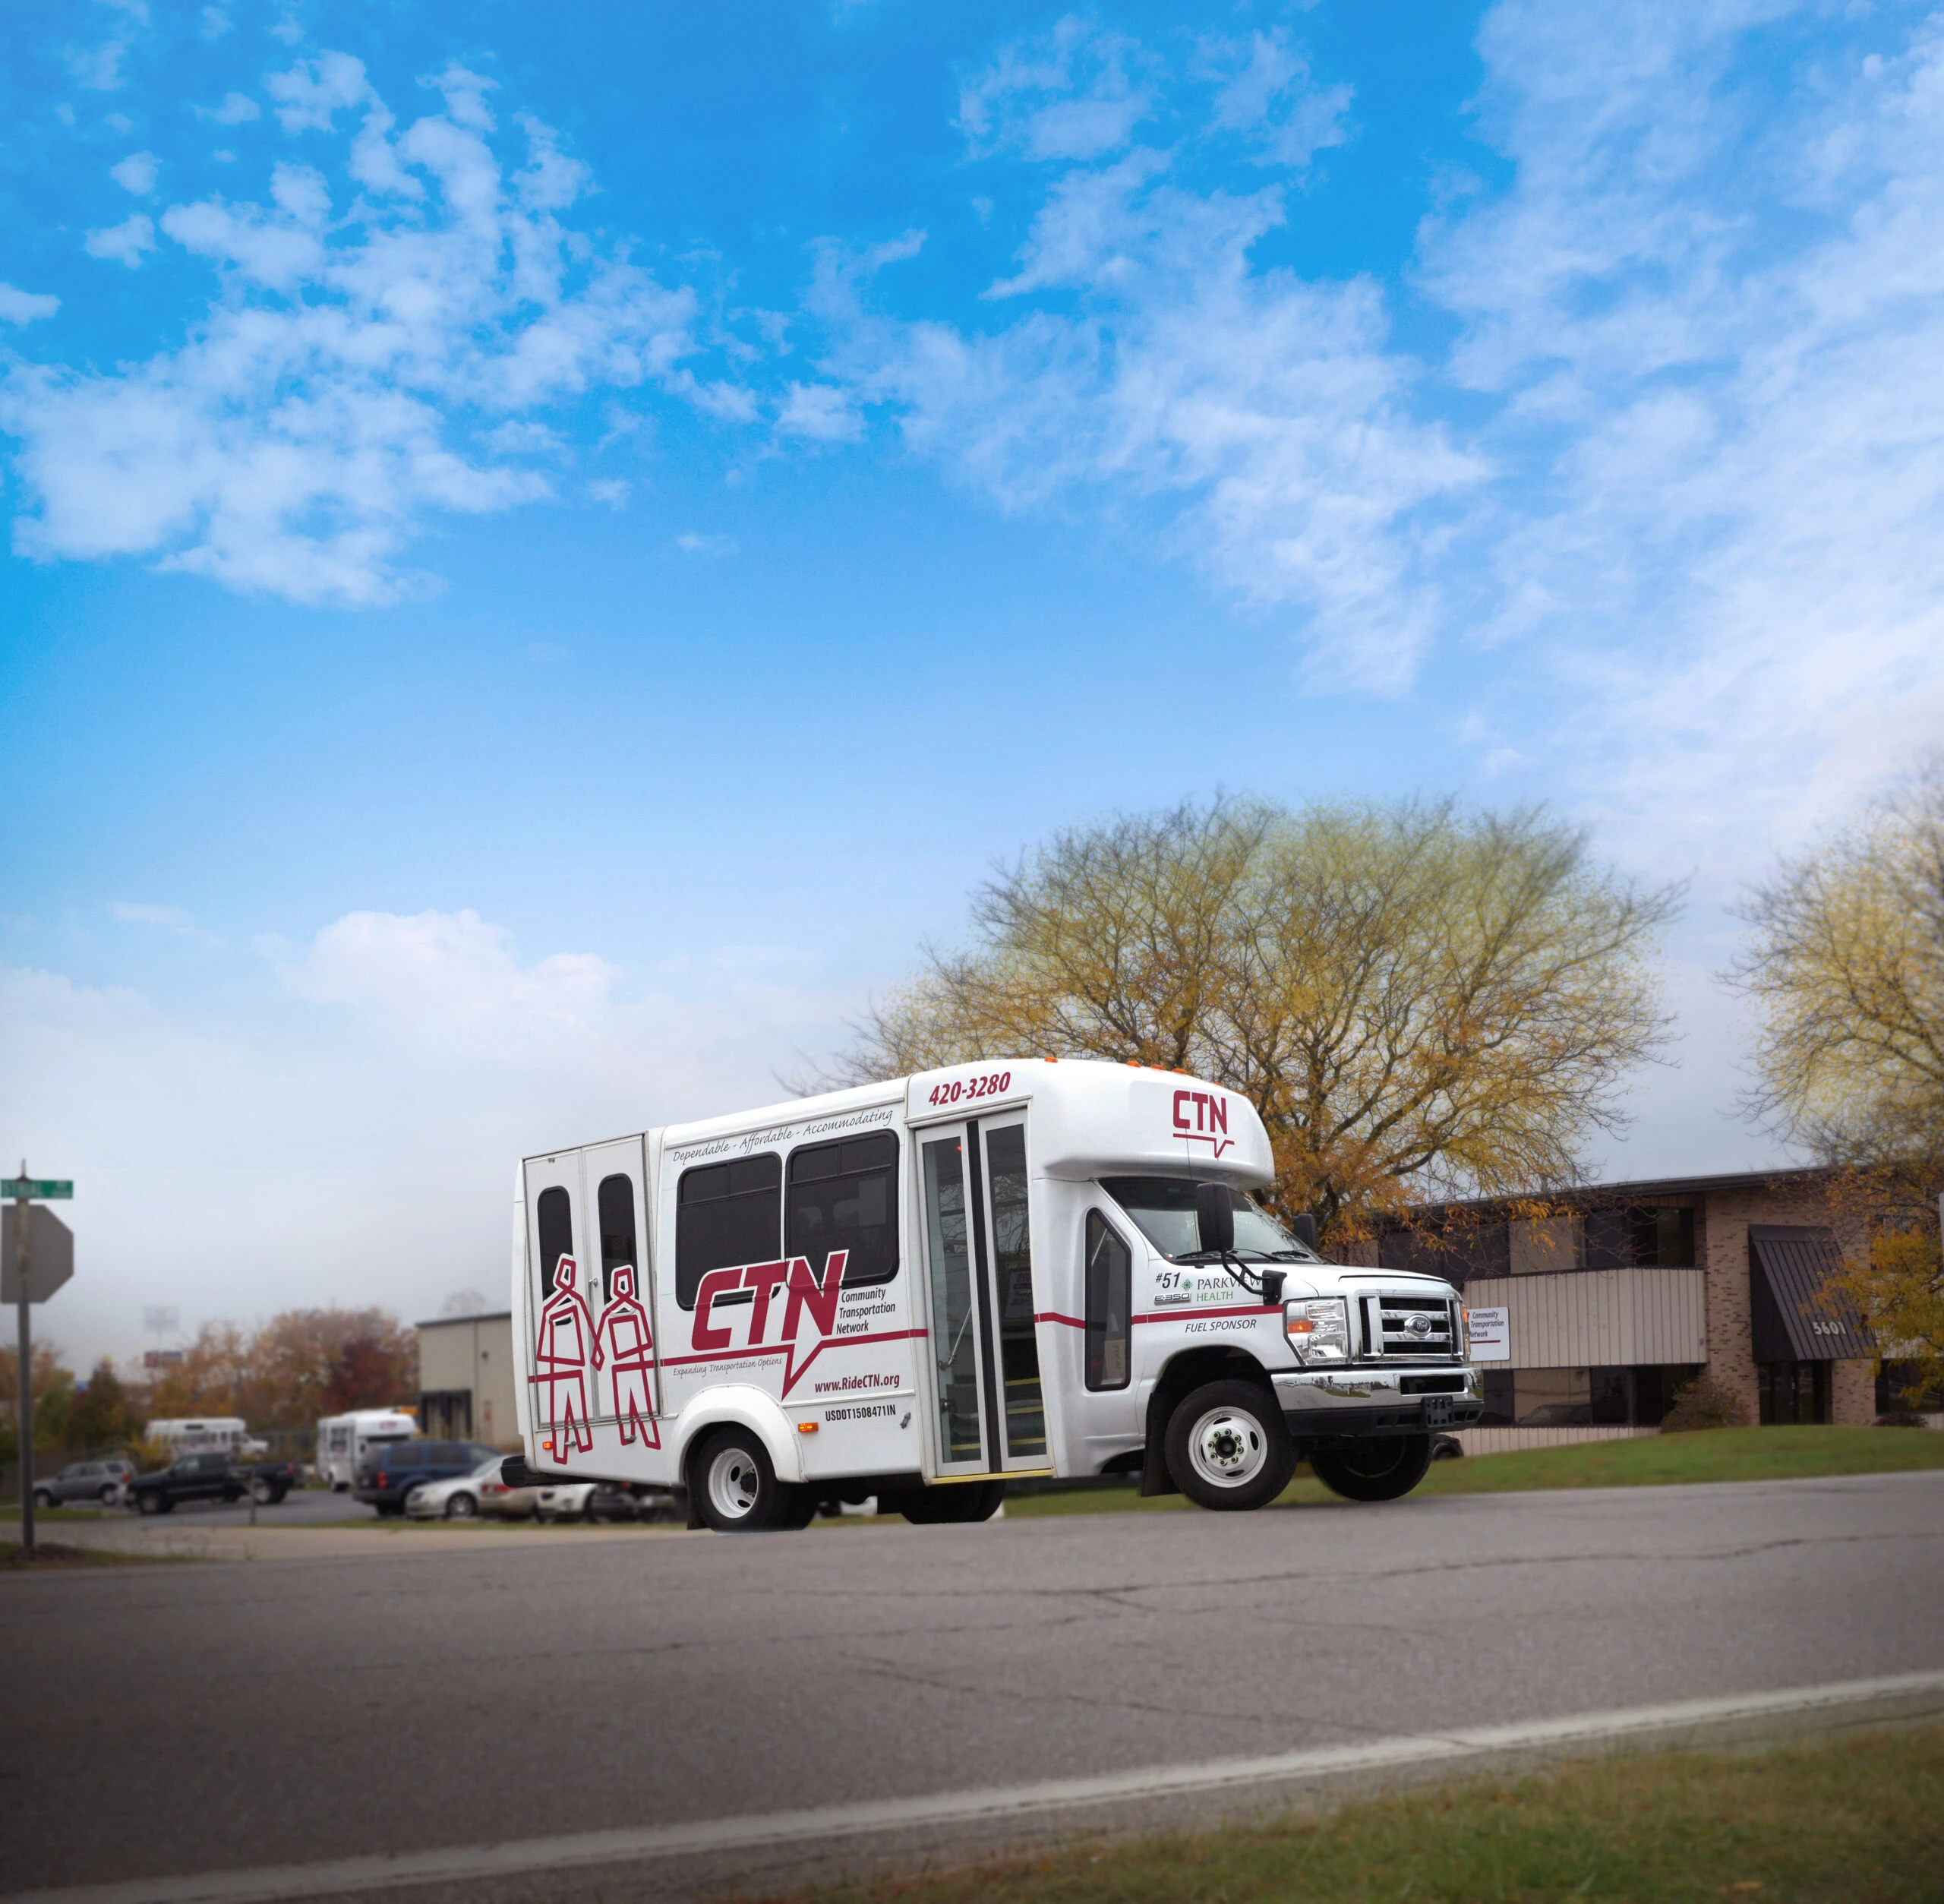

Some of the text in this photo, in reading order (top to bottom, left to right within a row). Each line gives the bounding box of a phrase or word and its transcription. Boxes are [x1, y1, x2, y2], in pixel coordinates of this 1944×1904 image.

[929, 1072, 1011, 1106] 420-3280
[1173, 1090, 1227, 1135] CTN
[673, 1140, 729, 1165] Dependable
[740, 1129, 792, 1154] Affordable
[803, 1110, 893, 1135] Accommodating
[1155, 1272, 1181, 1289] #51
[1198, 1276, 1263, 1290] PARKVW
[691, 1249, 849, 1351] CTN
[841, 1287, 886, 1302] Community
[1197, 1291, 1233, 1302] HEALTH
[839, 1302, 895, 1319] Transportation
[1472, 1311, 1499, 1319] Community
[837, 1319, 869, 1334] Network
[1185, 1319, 1257, 1333] FUEL SPONSOR
[1471, 1319, 1504, 1329] Transportation
[1813, 1321, 1847, 1335] 5601
[674, 1356, 782, 1379] Expanding Transportation Options
[815, 1374, 900, 1393] www.RideCTN.org
[825, 1404, 896, 1422] USDOT1508471IN
